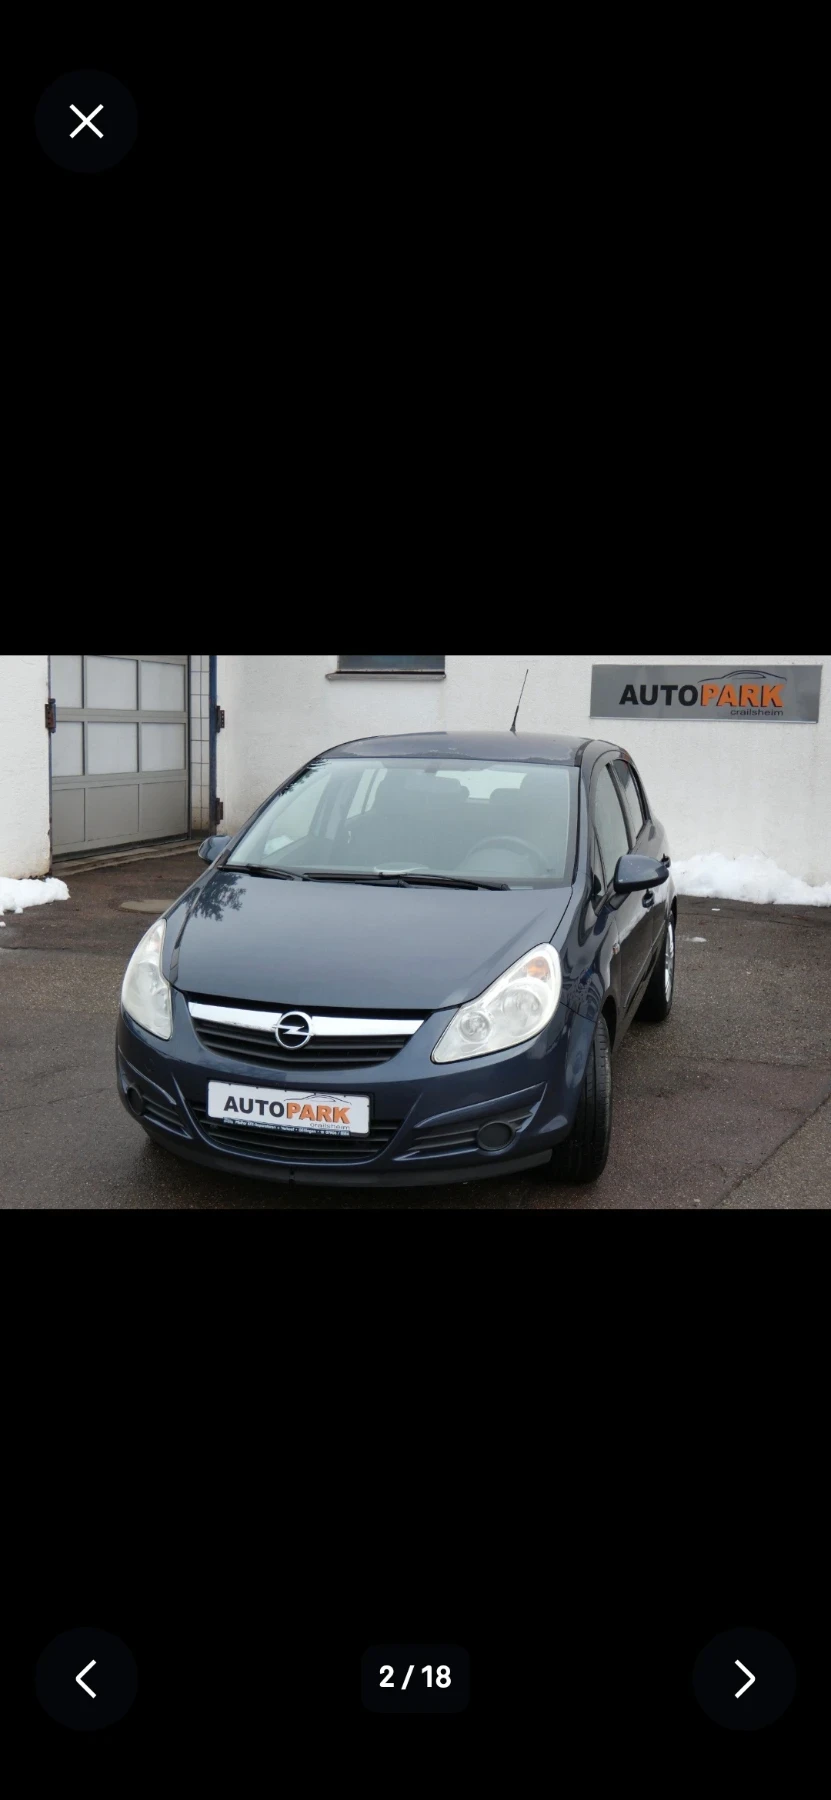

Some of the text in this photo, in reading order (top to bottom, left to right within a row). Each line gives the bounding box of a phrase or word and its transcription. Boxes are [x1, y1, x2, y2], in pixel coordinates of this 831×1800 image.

[619, 684, 785, 707] AUTOPARK
[730, 708, 783, 717] crailsheim
[223, 1096, 350, 1124] AUTOPARK
